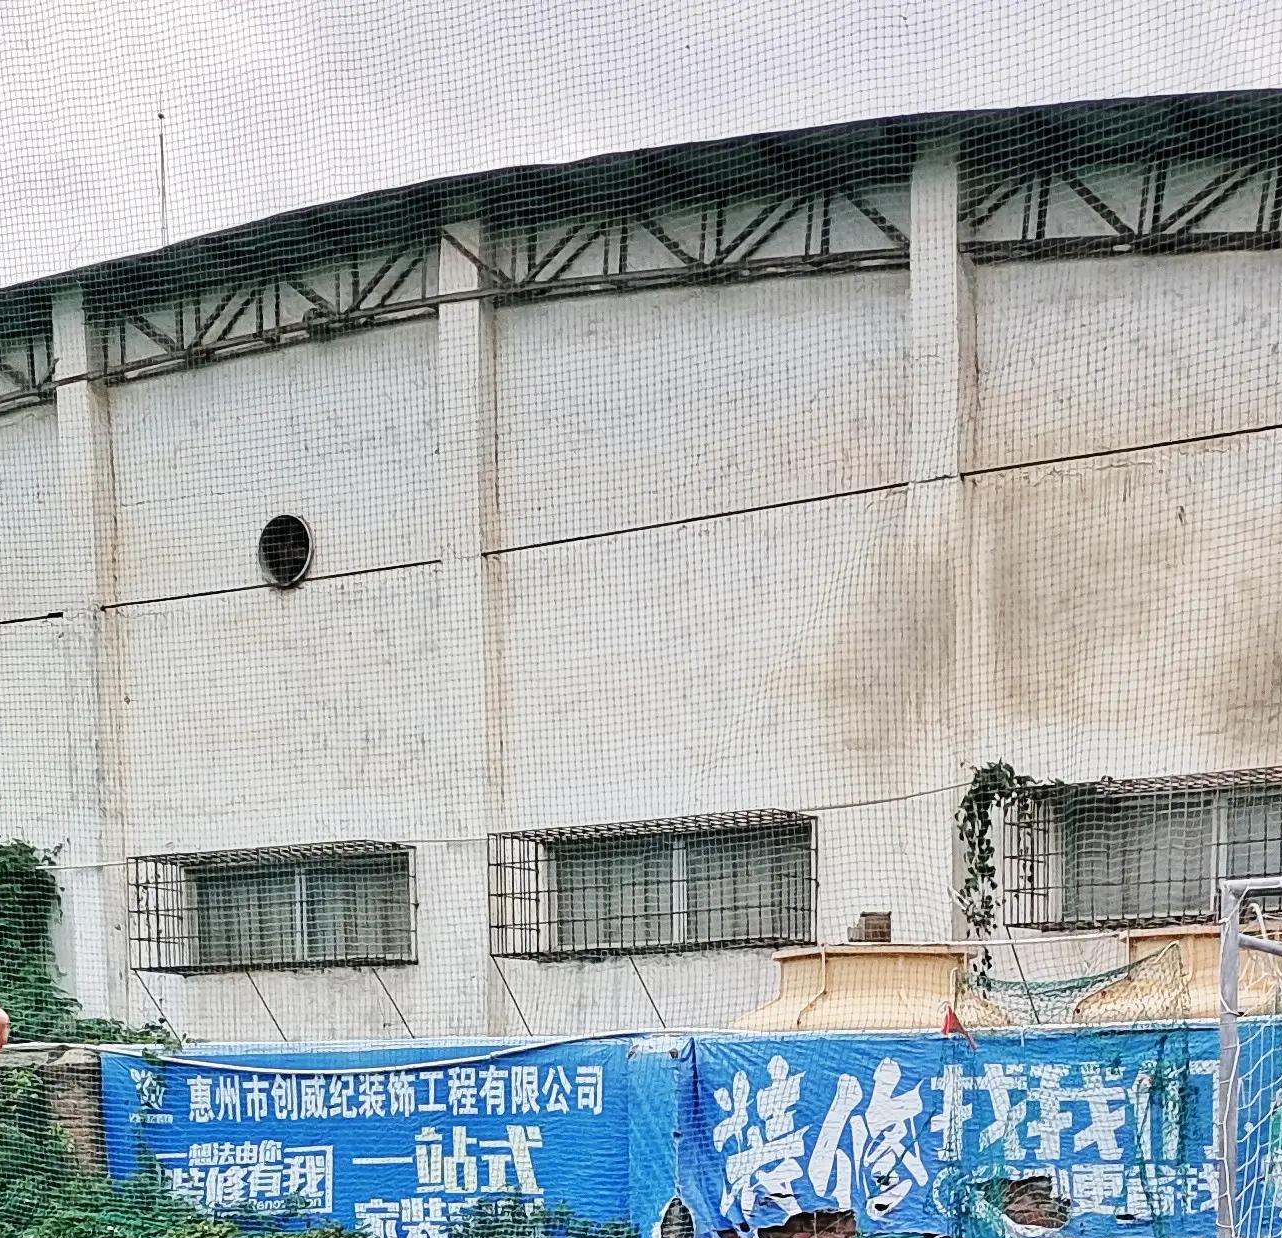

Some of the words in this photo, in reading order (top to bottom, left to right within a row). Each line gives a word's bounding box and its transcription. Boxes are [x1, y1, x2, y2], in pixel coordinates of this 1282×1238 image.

[187, 1065, 603, 1123] 惠州市创威纪装饰工程有限公司
[189, 1139, 282, 1167] 想法由你
[352, 1125, 545, 1195] 一站式
